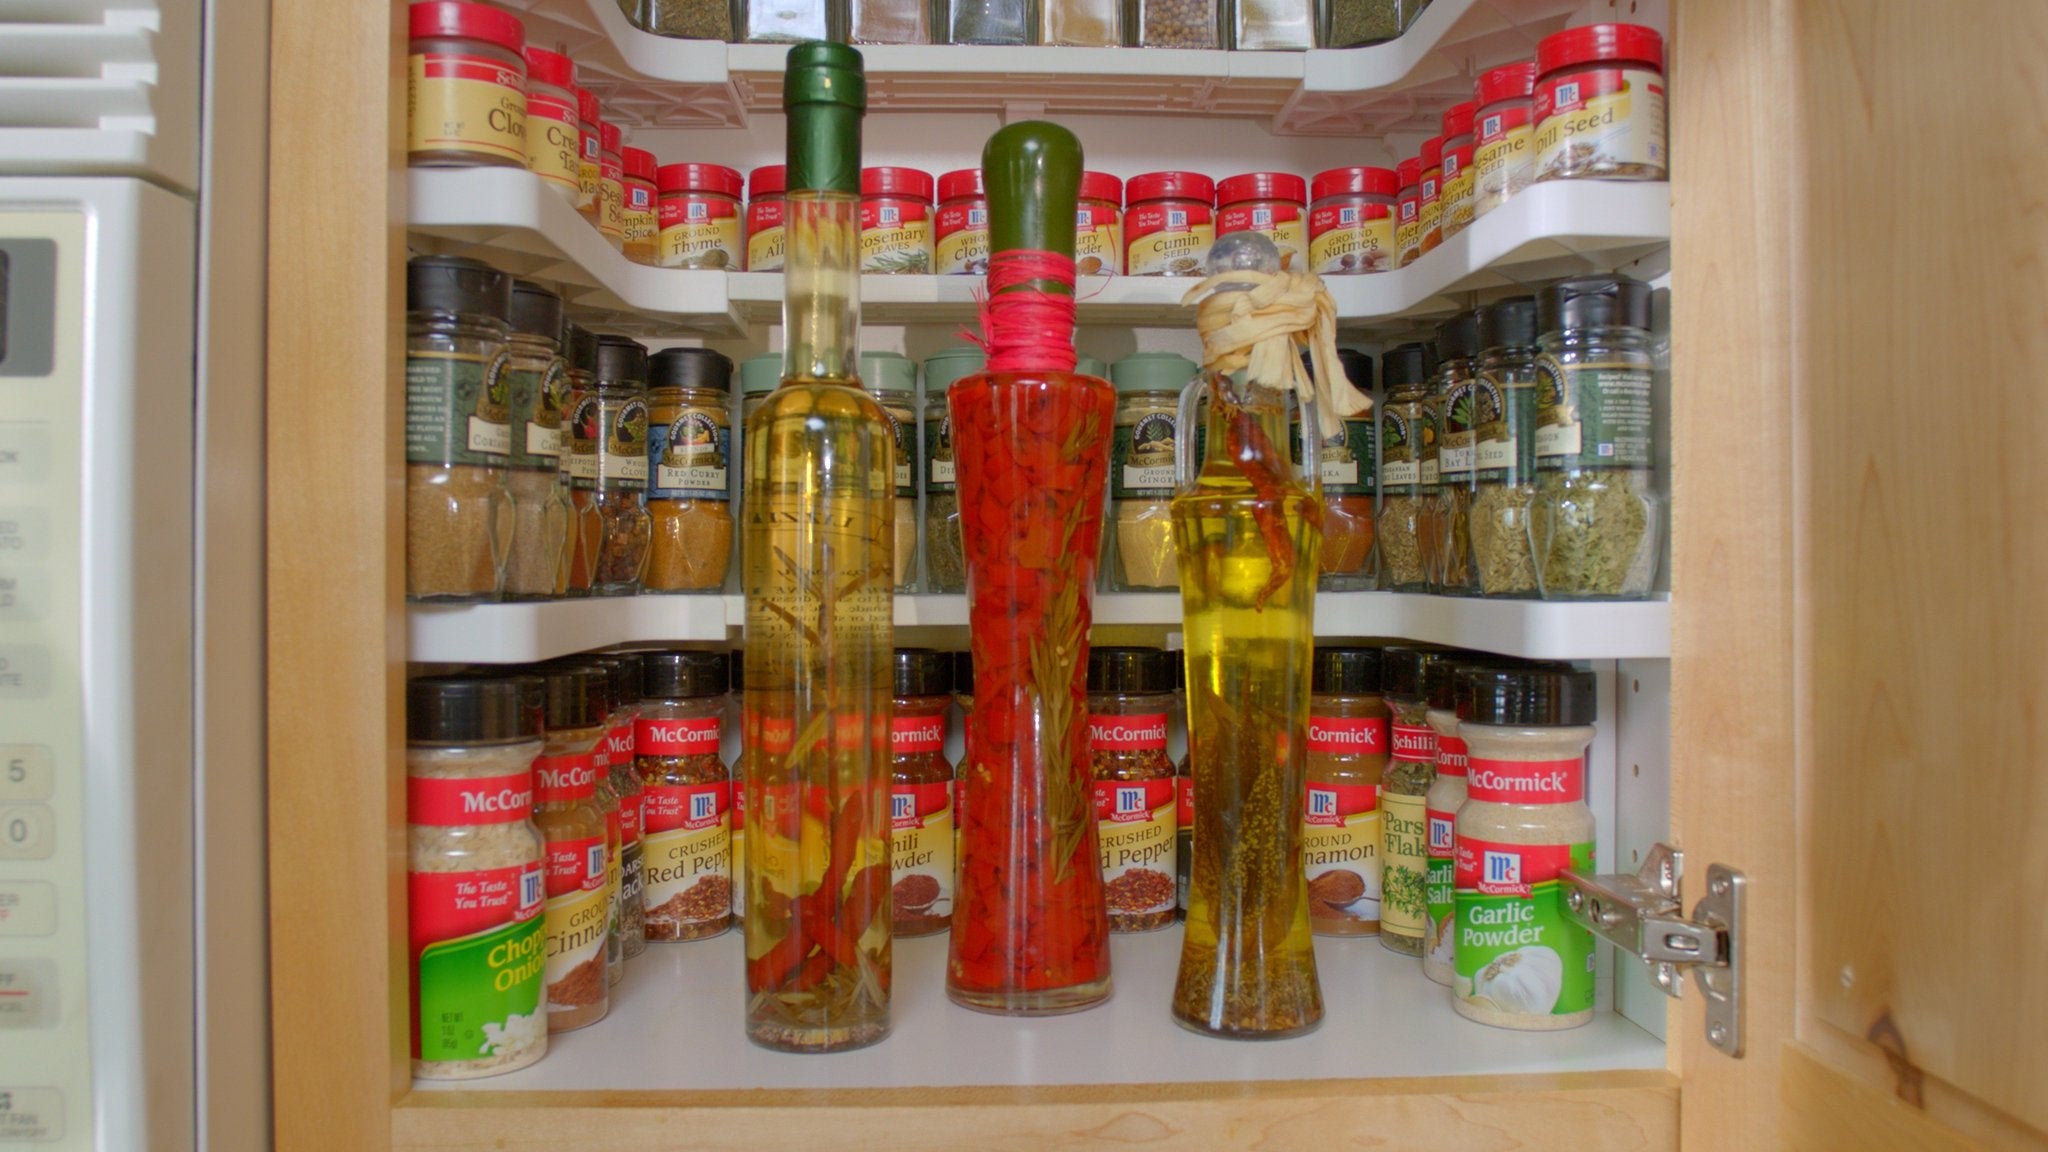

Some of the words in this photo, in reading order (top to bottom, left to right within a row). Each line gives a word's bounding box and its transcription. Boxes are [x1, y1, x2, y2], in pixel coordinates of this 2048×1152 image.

[1563, 107, 1614, 138] Seed
[674, 227, 720, 242] GROUND
[1153, 235, 1200, 253] Cumin
[1272, 231, 1290, 242] Pie
[1328, 228, 1373, 247] GROUND
[672, 237, 722, 256] Thyme
[871, 242, 910, 256] LEAVES
[1163, 248, 1191, 260] SEED
[1323, 236, 1379, 260] Nutmeg
[1090, 725, 1166, 743] McCormick
[1309, 726, 1374, 745] Cormick
[8, 759, 26, 782] 5
[1467, 769, 1565, 792] McCormick
[658, 796, 678, 804] Taste
[1111, 812, 1149, 822] McCormick
[1384, 811, 1424, 835] Pars
[9, 819, 28, 843] 0
[668, 830, 727, 860] CRUSHED
[1119, 836, 1175, 867] Pepper
[553, 852, 576, 862] Taste
[1305, 844, 1374, 866] namon
[647, 860, 685, 885] Red
[456, 882, 476, 894] The
[479, 881, 507, 893] Taste
[1478, 882, 1529, 895] McCormick
[455, 898, 477, 909] You
[1470, 902, 1535, 925] Garlic
[1463, 925, 1544, 946] Powder
